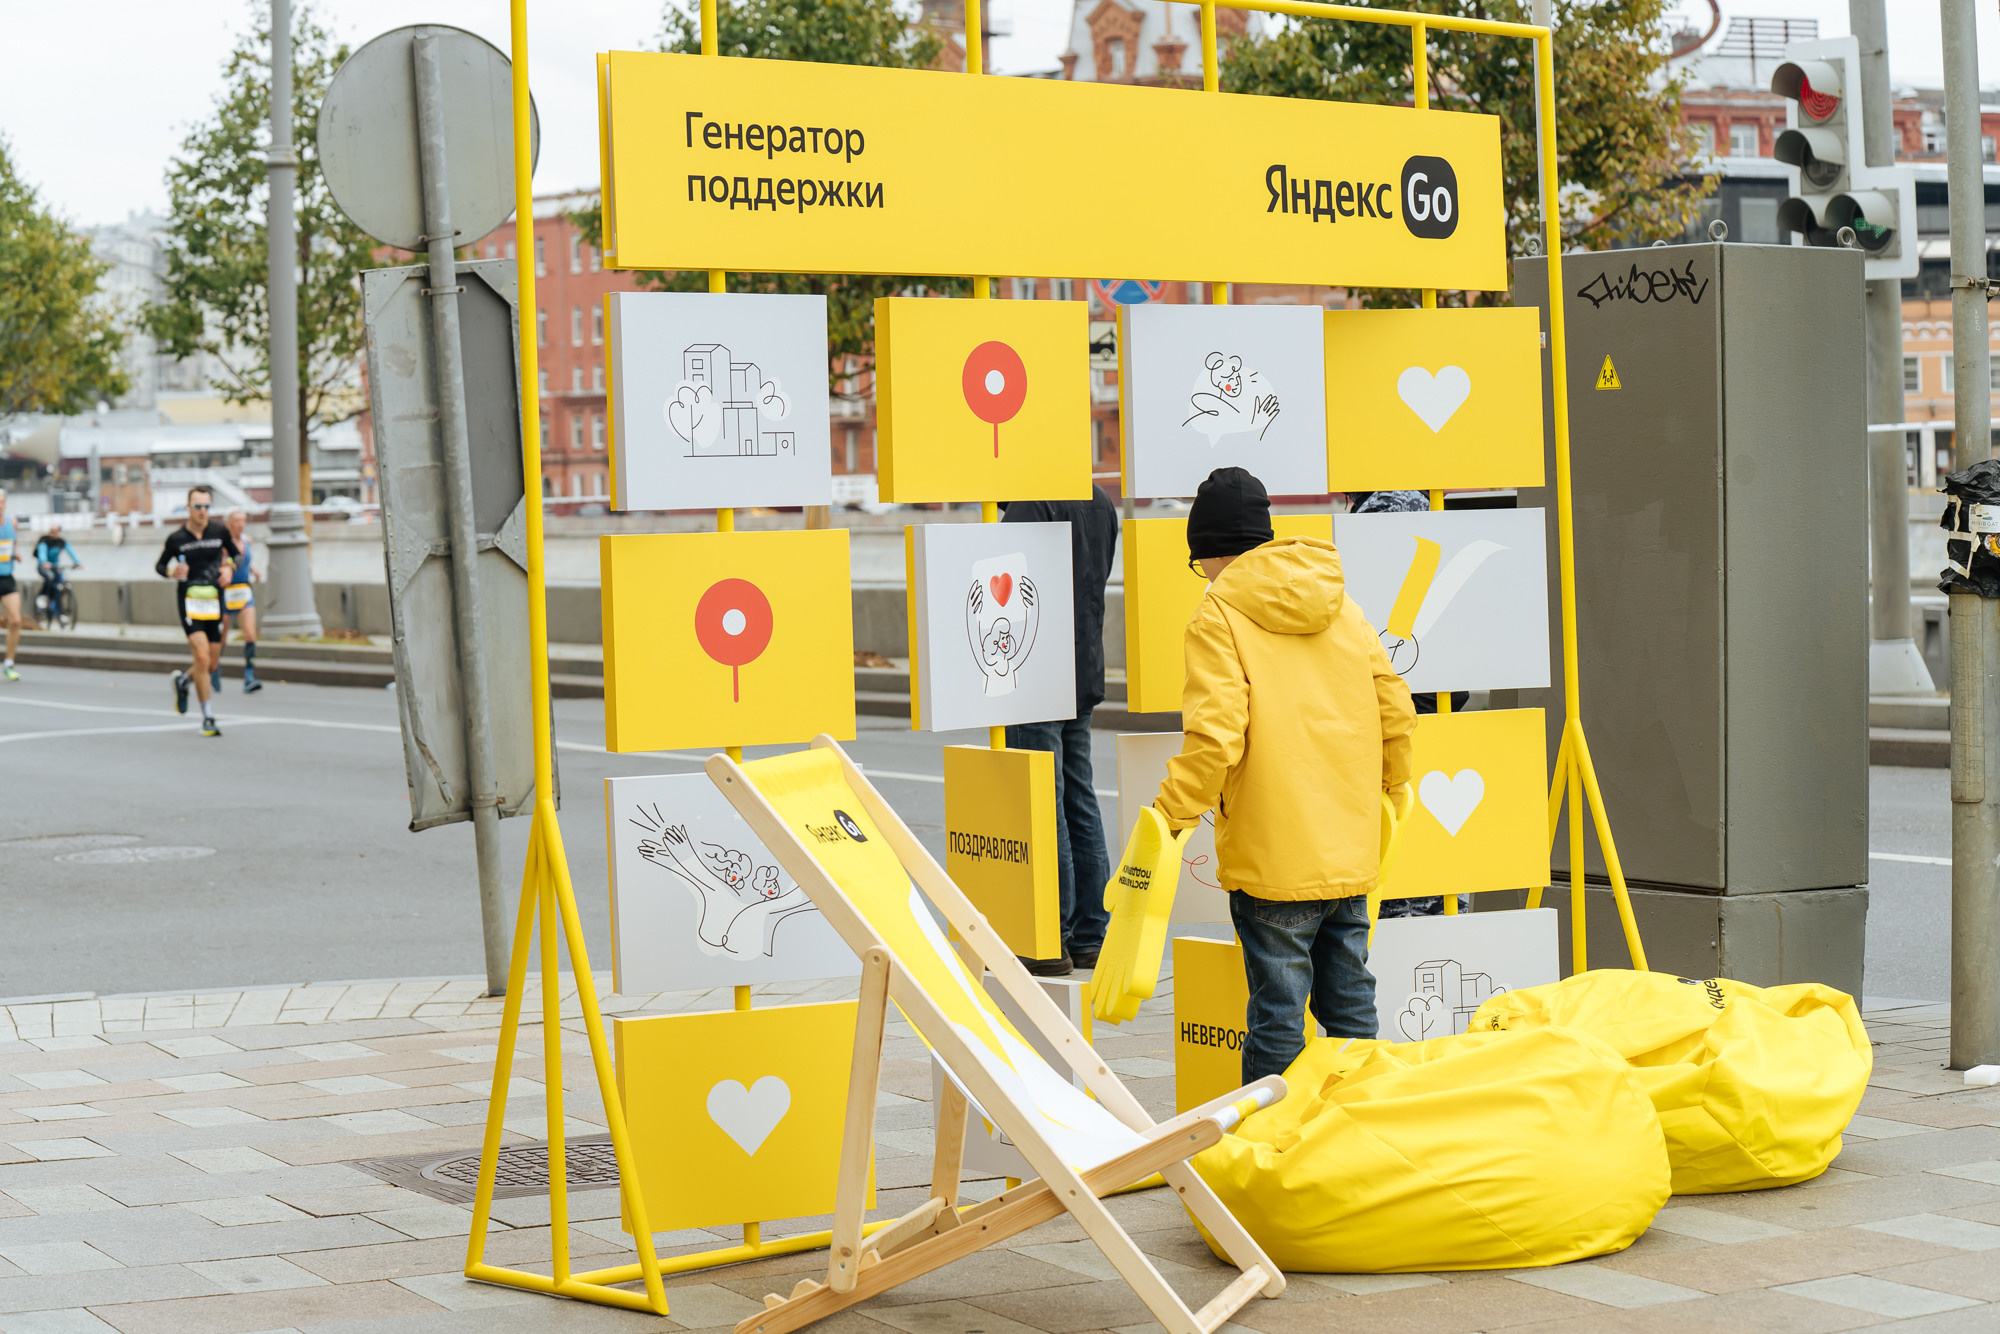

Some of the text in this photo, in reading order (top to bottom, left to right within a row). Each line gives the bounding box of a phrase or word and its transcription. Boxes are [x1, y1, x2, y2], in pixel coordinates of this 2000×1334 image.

[686, 111, 865, 164] Генератор
[687, 174, 885, 214] поддержки
[1265, 164, 1454, 226] Яндекс Go
[949, 830, 1029, 865] ПОЗДРАВЛЯЕМ
